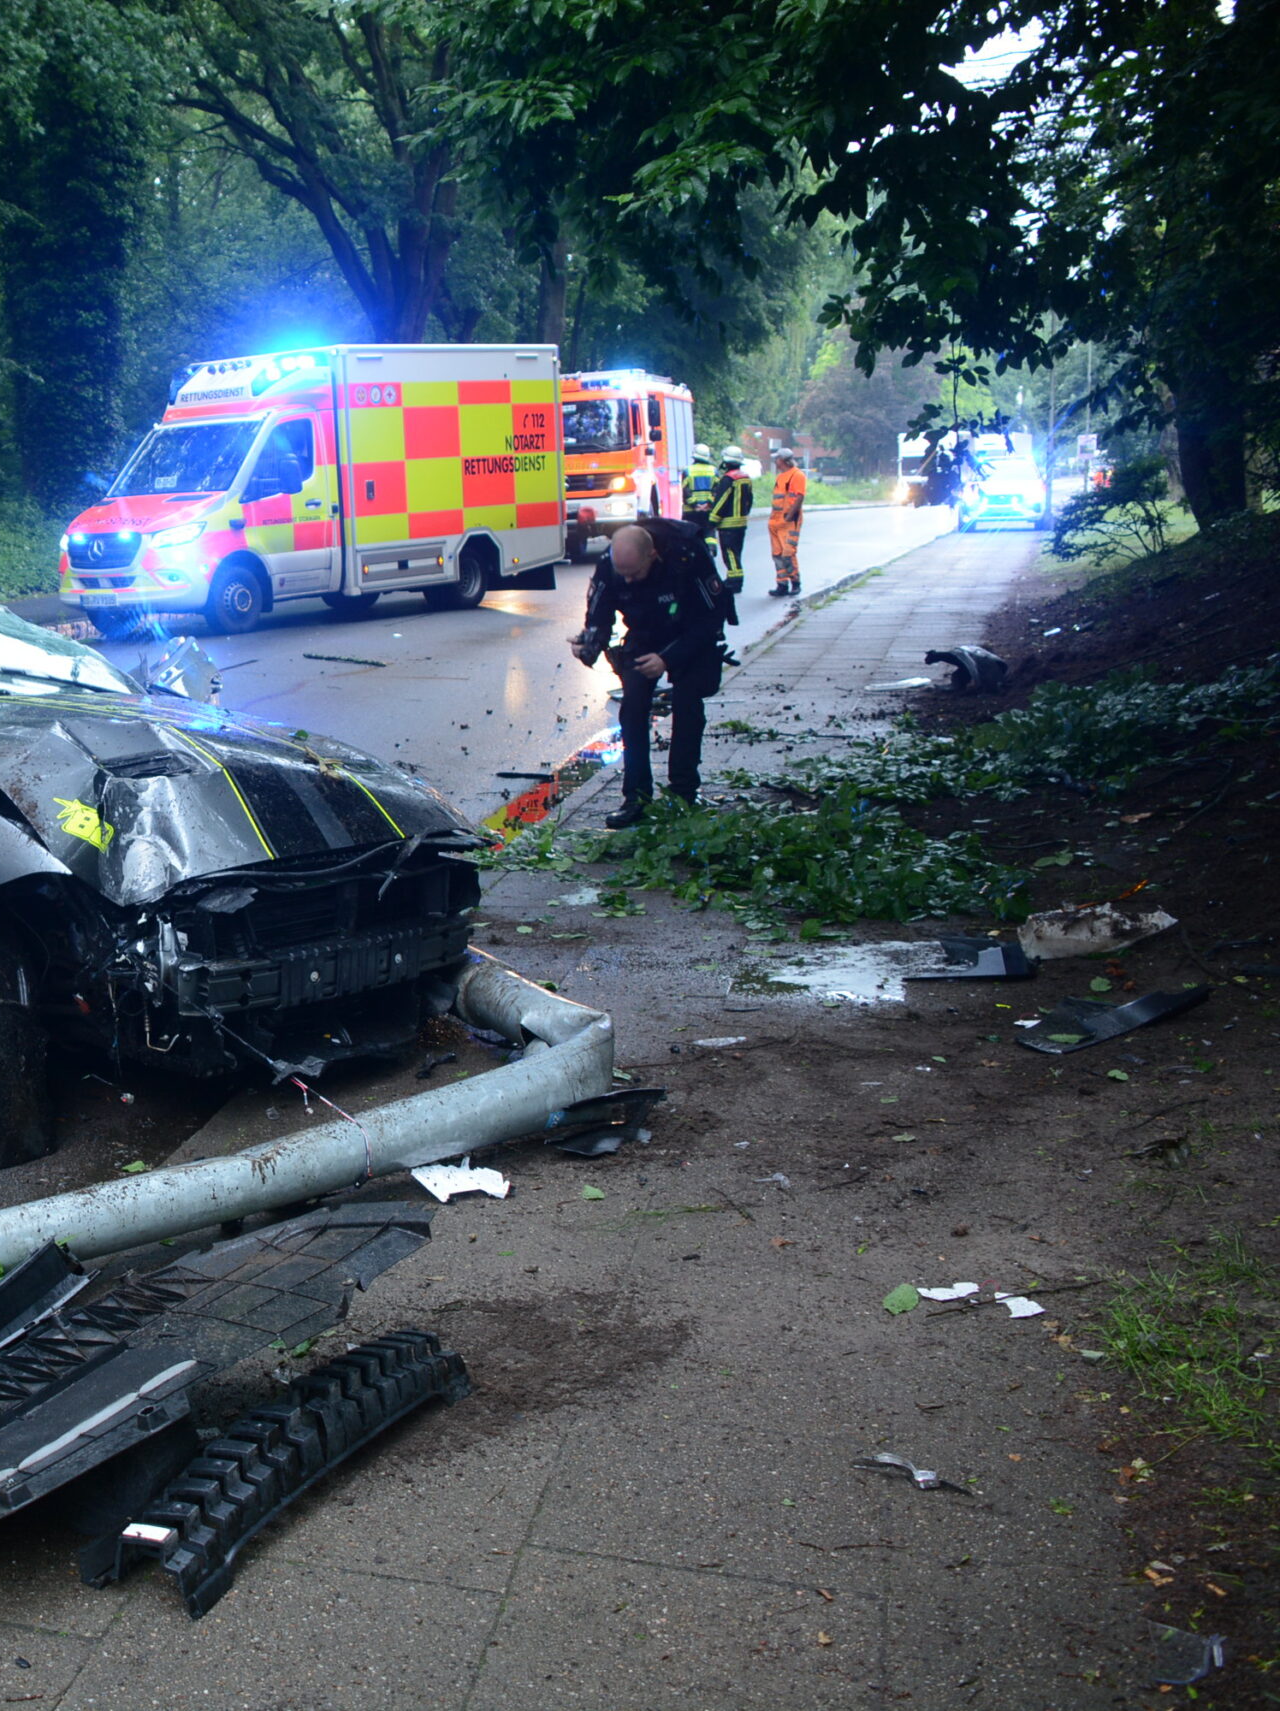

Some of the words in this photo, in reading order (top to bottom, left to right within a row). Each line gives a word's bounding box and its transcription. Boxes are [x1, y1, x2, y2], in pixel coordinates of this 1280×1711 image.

[181, 387, 244, 402] RETTUNGSDIENST
[531, 413, 545, 428] 112
[505, 434, 546, 451] NOTARZT
[464, 455, 546, 475] RETTUNGSDIENST
